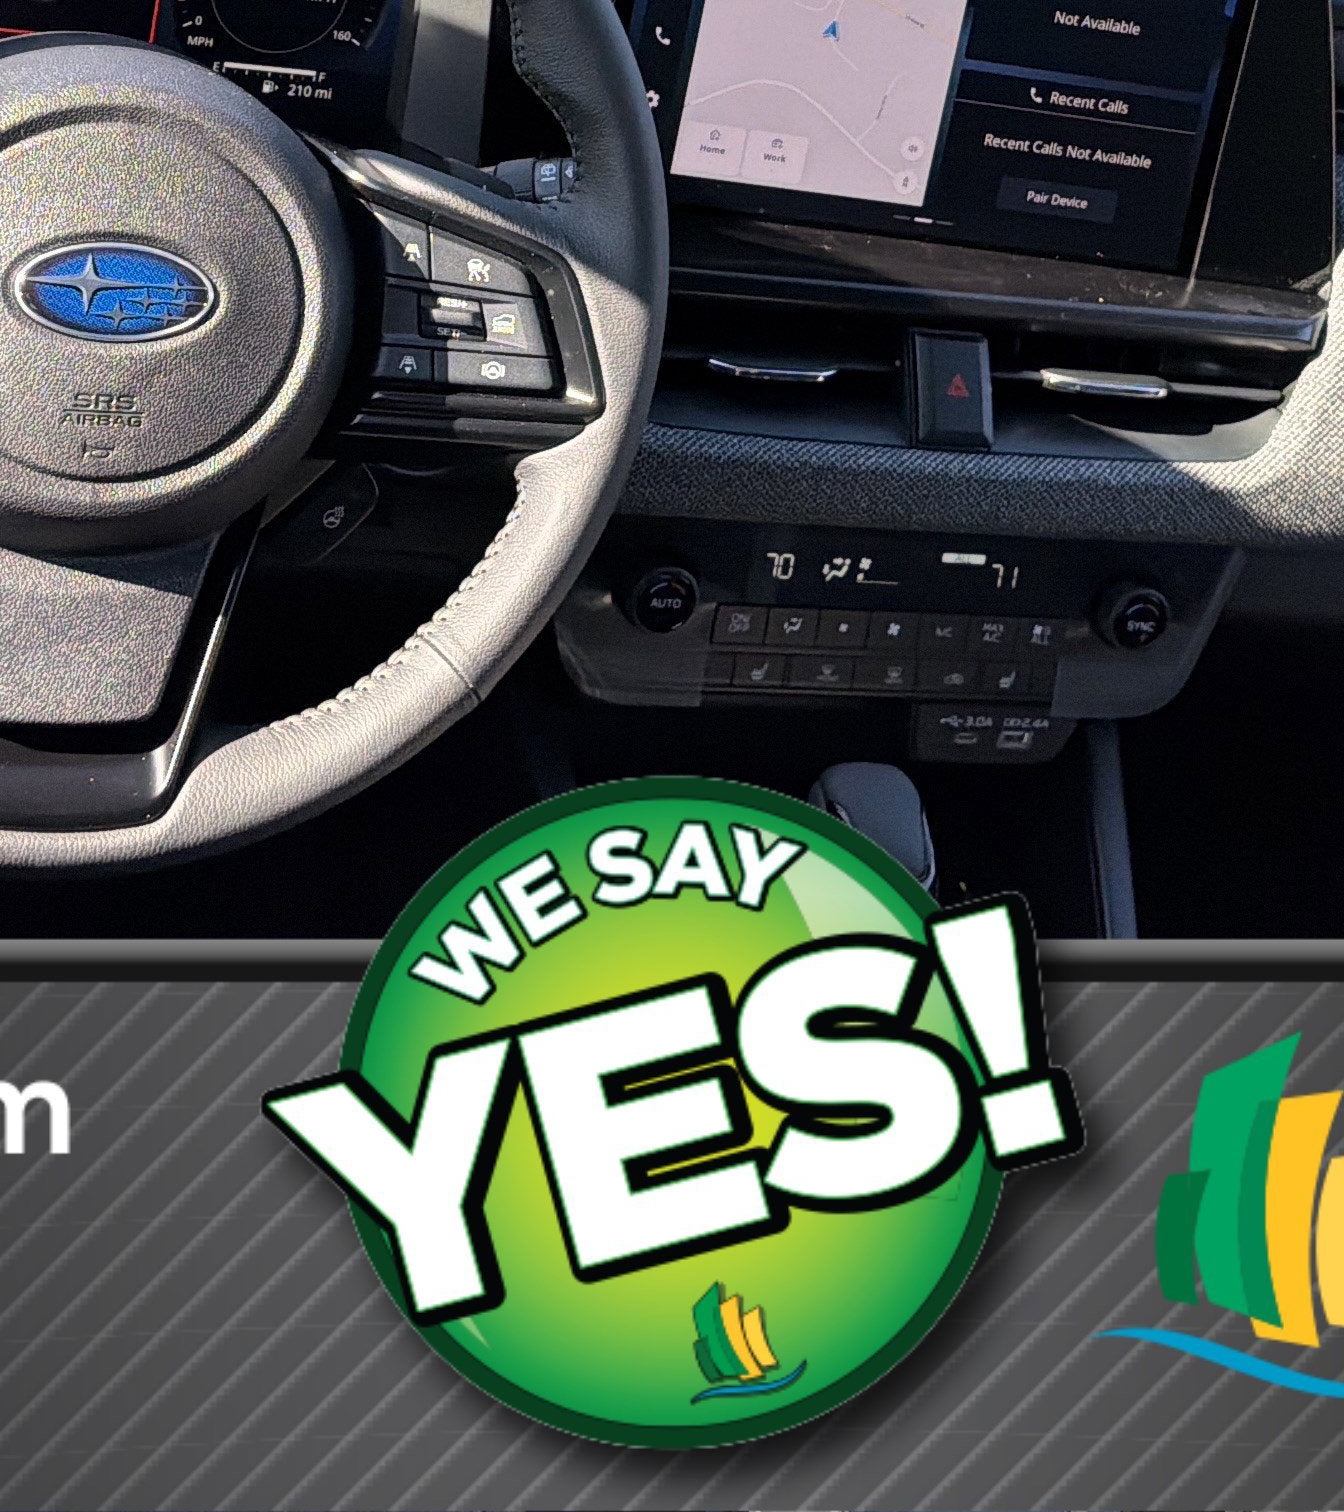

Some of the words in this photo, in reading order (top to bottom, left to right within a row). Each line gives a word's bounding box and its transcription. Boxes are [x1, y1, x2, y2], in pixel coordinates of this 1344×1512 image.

[194, 15, 203, 26] 0
[1053, 10, 1080, 28] Not
[1080, 14, 1142, 37] Available
[187, 34, 214, 48] MPH
[332, 29, 352, 42] 160
[212, 61, 221, 73] E
[318, 72, 327, 82] F
[287, 84, 313, 99] 210
[314, 86, 333, 101] mi
[1049, 91, 1096, 110] Recent
[1098, 97, 1130, 115] Calls
[699, 143, 726, 156] Home
[983, 133, 1030, 153] Recent
[1032, 140, 1064, 157] Calls
[1065, 145, 1092, 162] Not
[1092, 148, 1153, 170] Available
[763, 152, 787, 164] Work
[1026, 189, 1049, 206] Pair
[1050, 193, 1089, 210] Device
[71, 392, 137, 411] SRS
[61, 413, 144, 428] AIRBAG
[766, 552, 795, 580] 70
[991, 563, 1019, 588] 71
[649, 597, 682, 609] AUTO
[1126, 619, 1156, 633] SYNC
